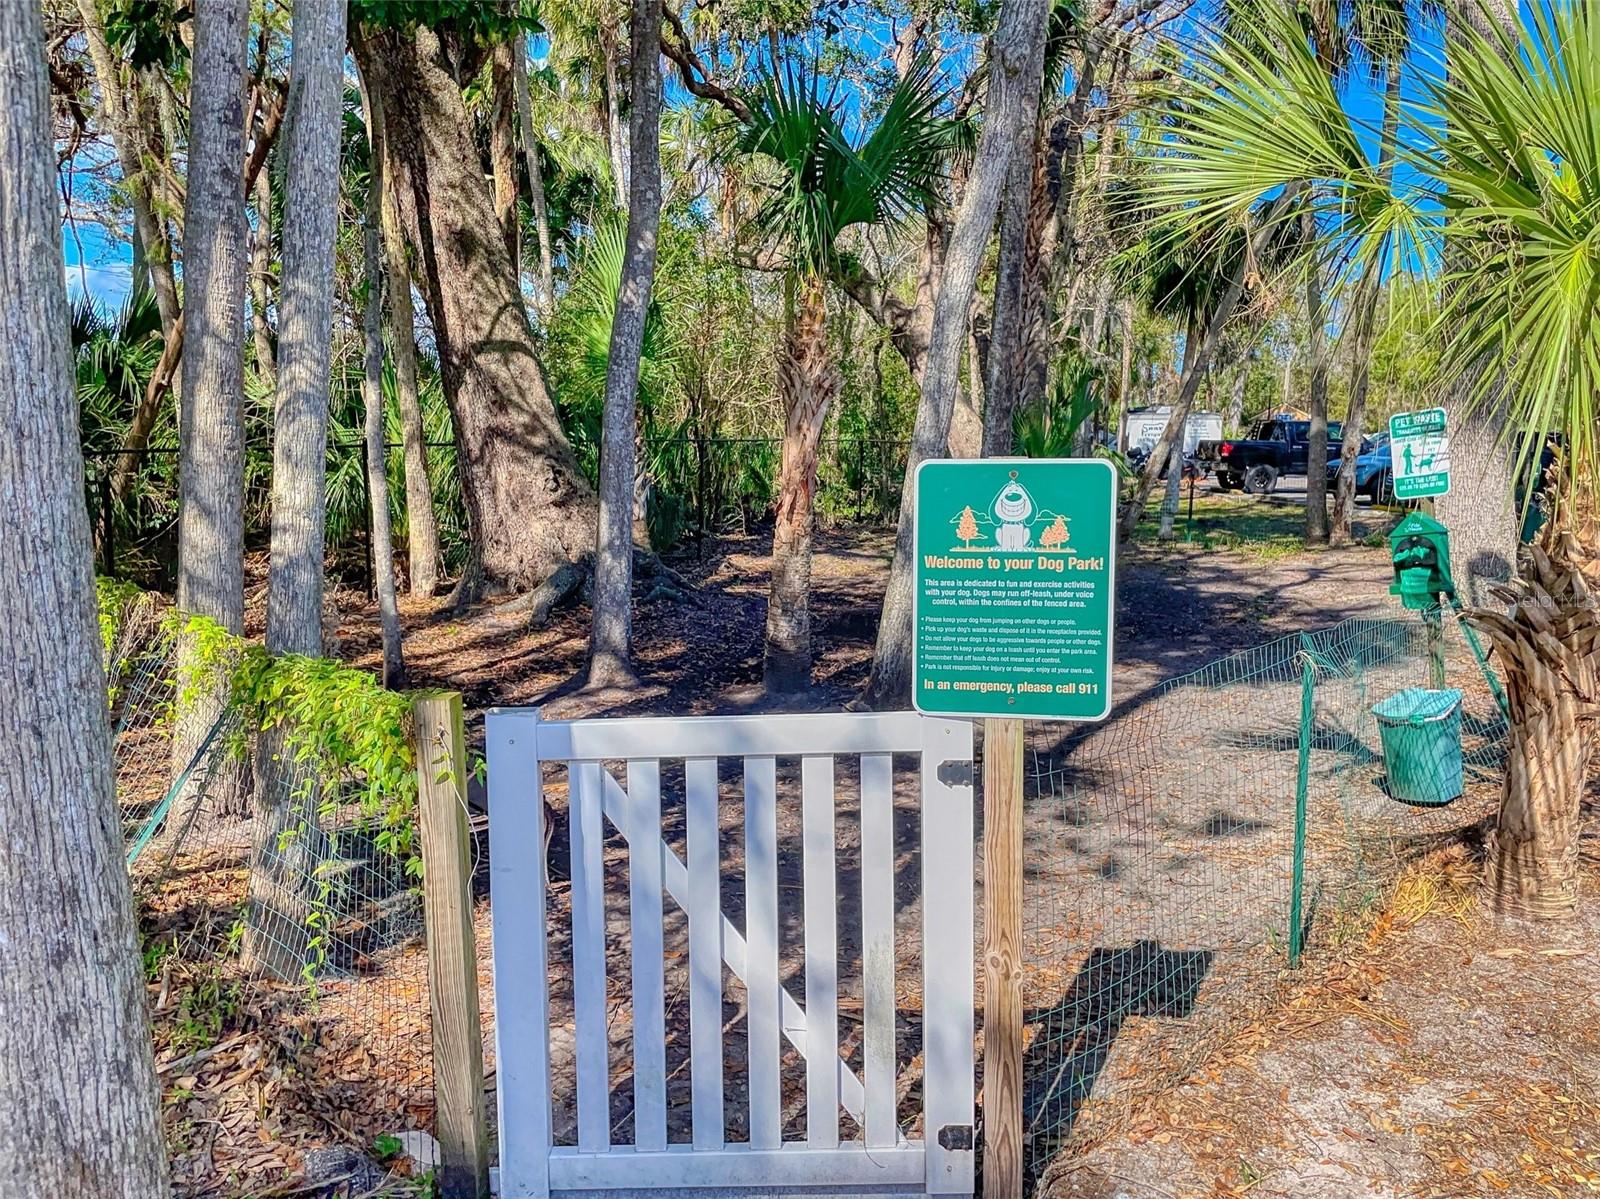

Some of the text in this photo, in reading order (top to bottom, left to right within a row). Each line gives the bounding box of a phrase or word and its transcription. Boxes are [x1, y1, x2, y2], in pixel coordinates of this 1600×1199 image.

[1395, 417, 1409, 428] PET
[924, 555, 1103, 572] Welcome to your Dog Park!
[924, 578, 939, 586] This
[963, 579, 997, 587] dedicated
[956, 589, 972, 597] dog.
[972, 589, 990, 597] Dogs
[991, 590, 1006, 598] may
[1020, 589, 1053, 598] off-leash,
[1053, 590, 1074, 598] under
[1075, 590, 1094, 598] voice
[980, 598, 992, 606] the
[1044, 599, 1068, 607] fenced
[924, 679, 1097, 694] In an emergency, please call 911
